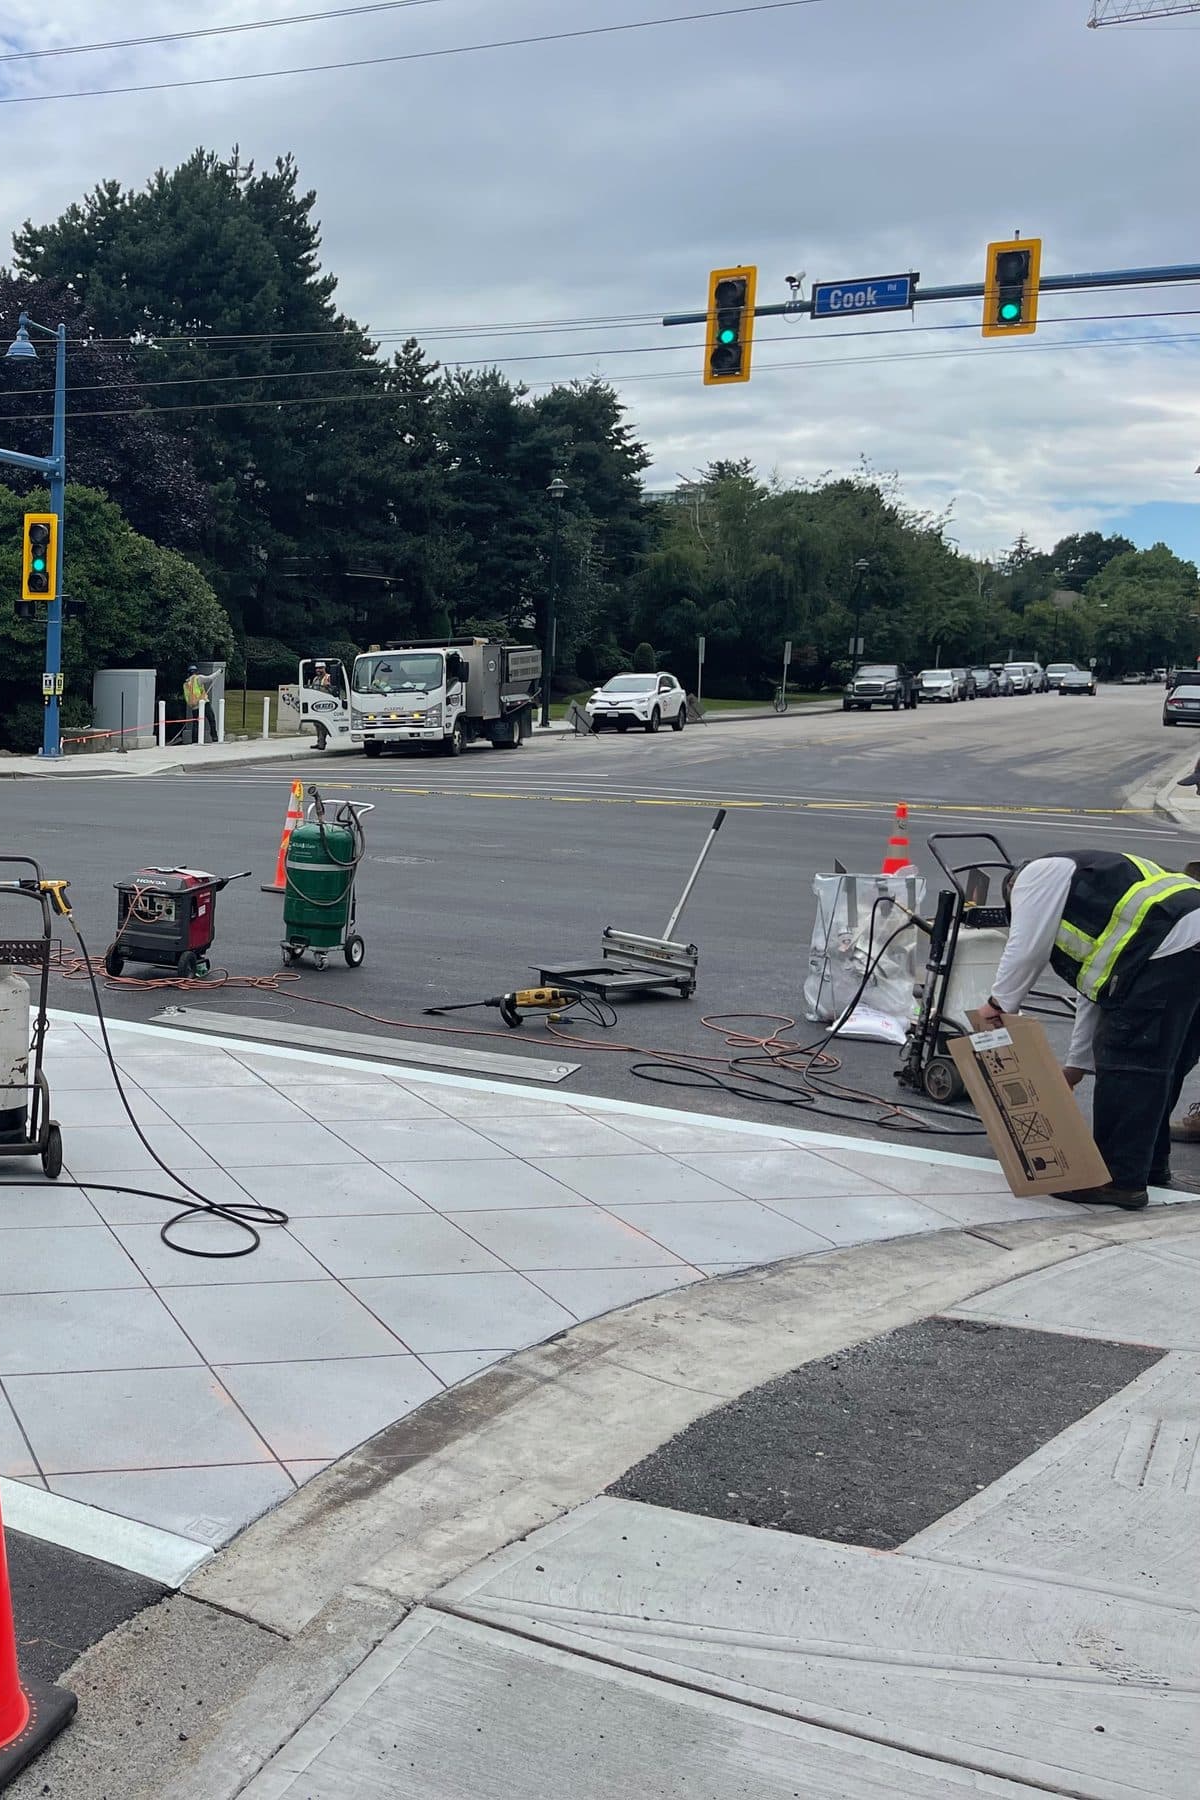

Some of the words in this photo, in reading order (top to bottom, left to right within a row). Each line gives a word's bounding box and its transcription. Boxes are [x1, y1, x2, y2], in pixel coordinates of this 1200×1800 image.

[830, 286, 877, 310] Cook
[887, 283, 897, 291] Rd
[136, 878, 167, 886] HONDA
